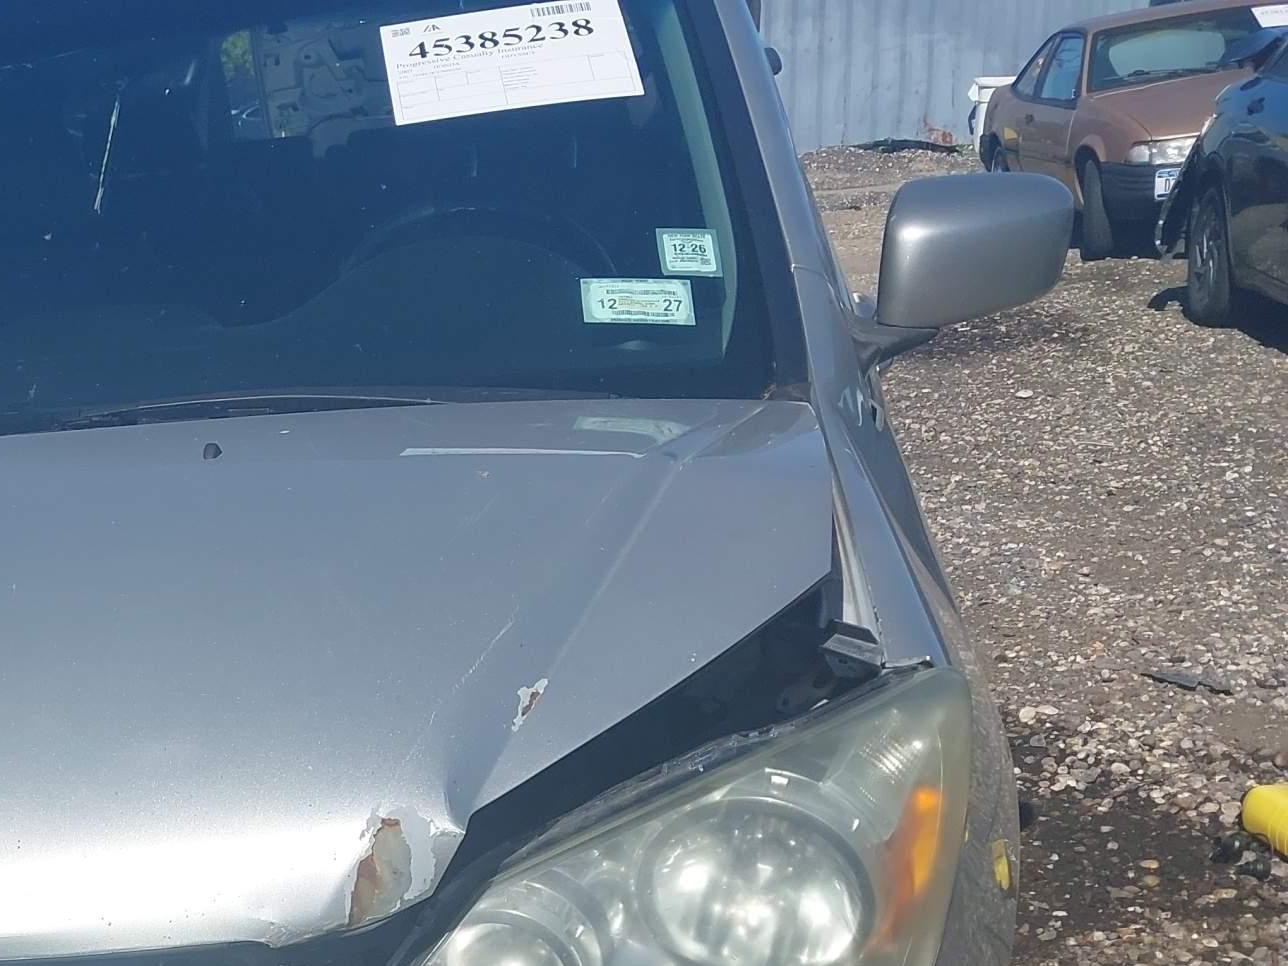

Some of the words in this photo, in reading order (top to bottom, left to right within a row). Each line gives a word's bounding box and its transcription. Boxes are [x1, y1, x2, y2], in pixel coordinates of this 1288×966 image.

[409, 18, 594, 59] 45385238
[598, 298, 618, 310] 12
[662, 298, 683, 312] 27
